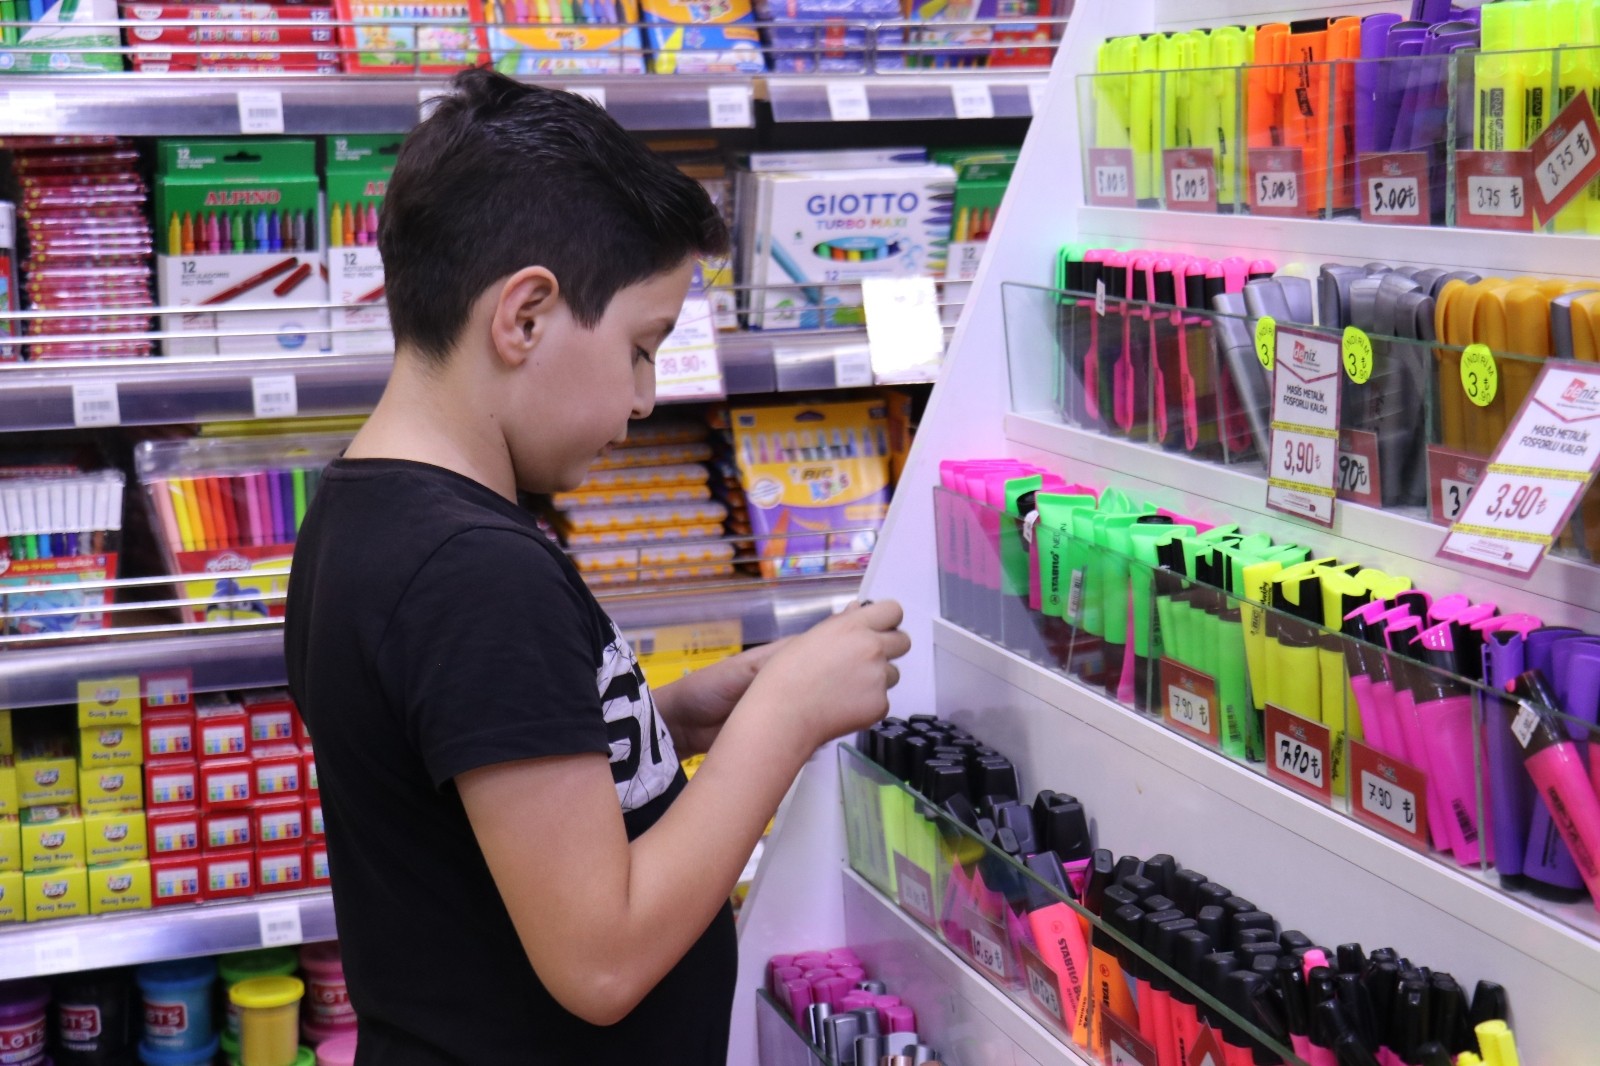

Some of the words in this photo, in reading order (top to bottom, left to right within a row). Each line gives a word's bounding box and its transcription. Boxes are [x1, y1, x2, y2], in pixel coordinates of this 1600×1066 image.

[205, 190, 281, 206] ALPINO
[807, 192, 919, 215] GIOTTO
[817, 219, 867, 231] TURBO
[870, 217, 908, 229] MAXI
[182, 261, 196, 273] 12
[343, 253, 357, 265] 12
[1058, 937, 1080, 985] STABILO
[1102, 980, 1110, 1008] STAB
